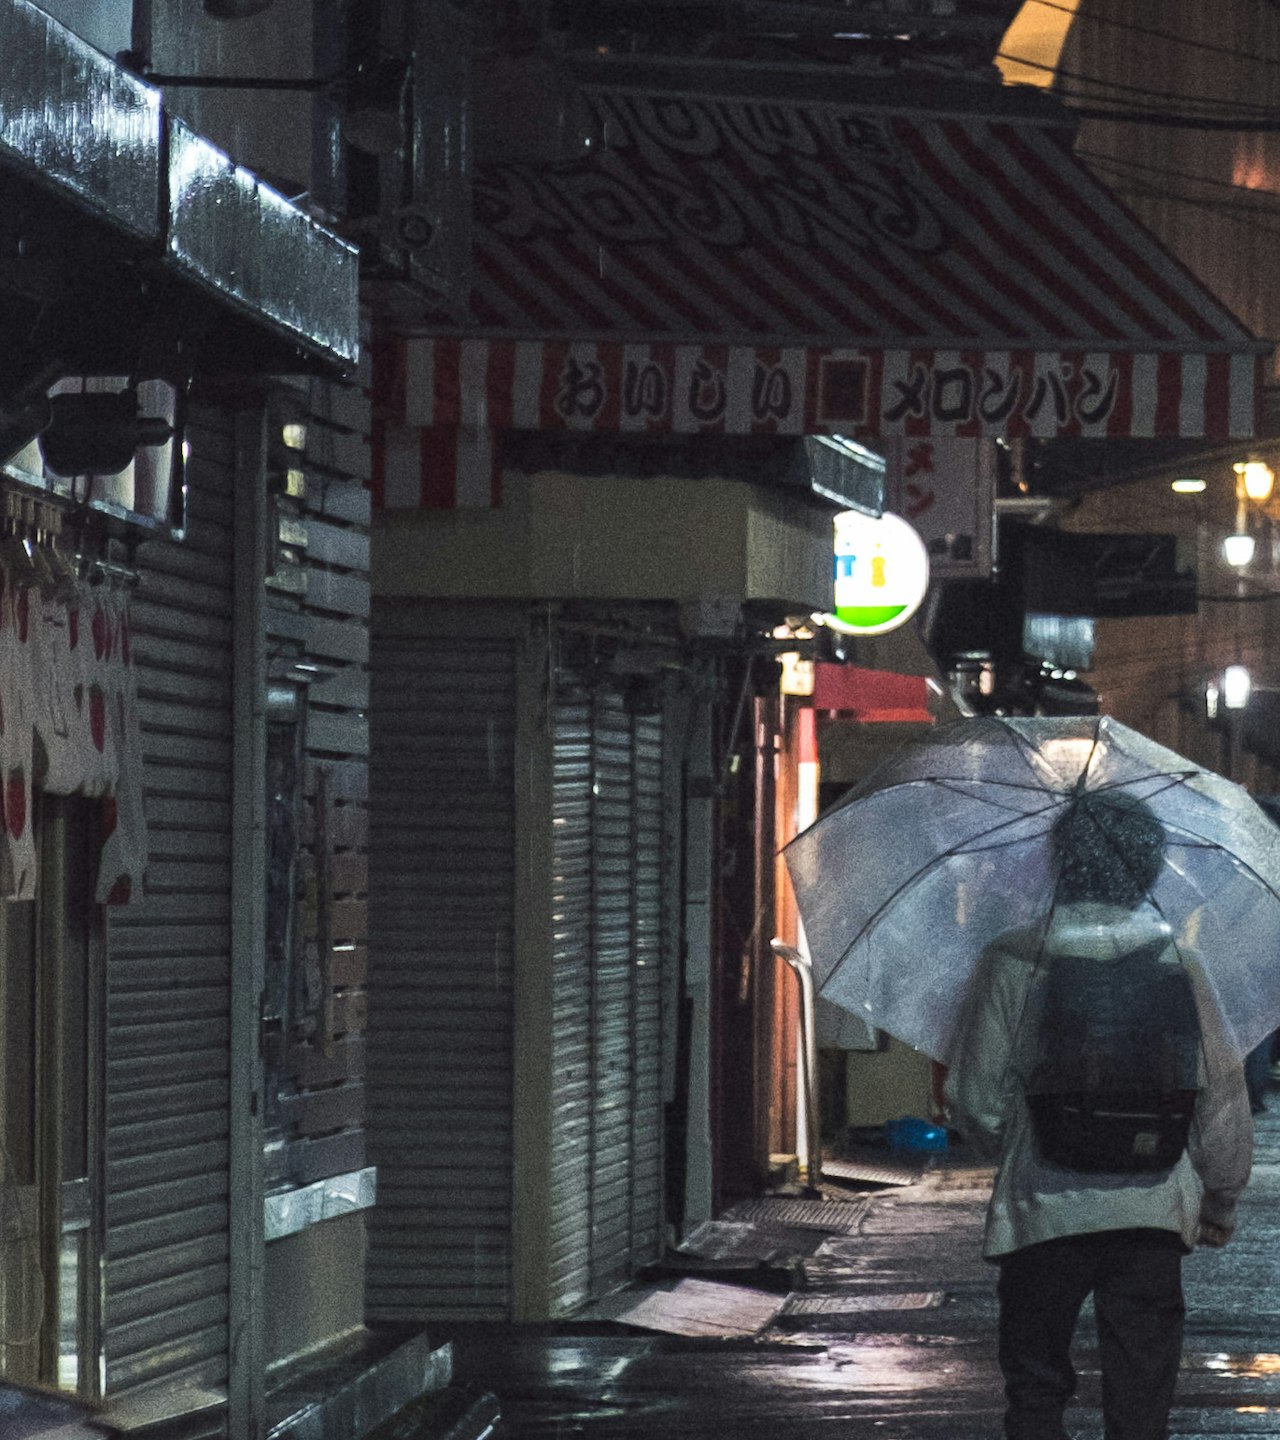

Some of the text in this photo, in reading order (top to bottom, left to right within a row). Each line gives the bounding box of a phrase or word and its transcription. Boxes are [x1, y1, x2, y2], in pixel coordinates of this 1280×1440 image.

[557, 356, 794, 422] おいしい
[884, 358, 1120, 424] メロンパン
